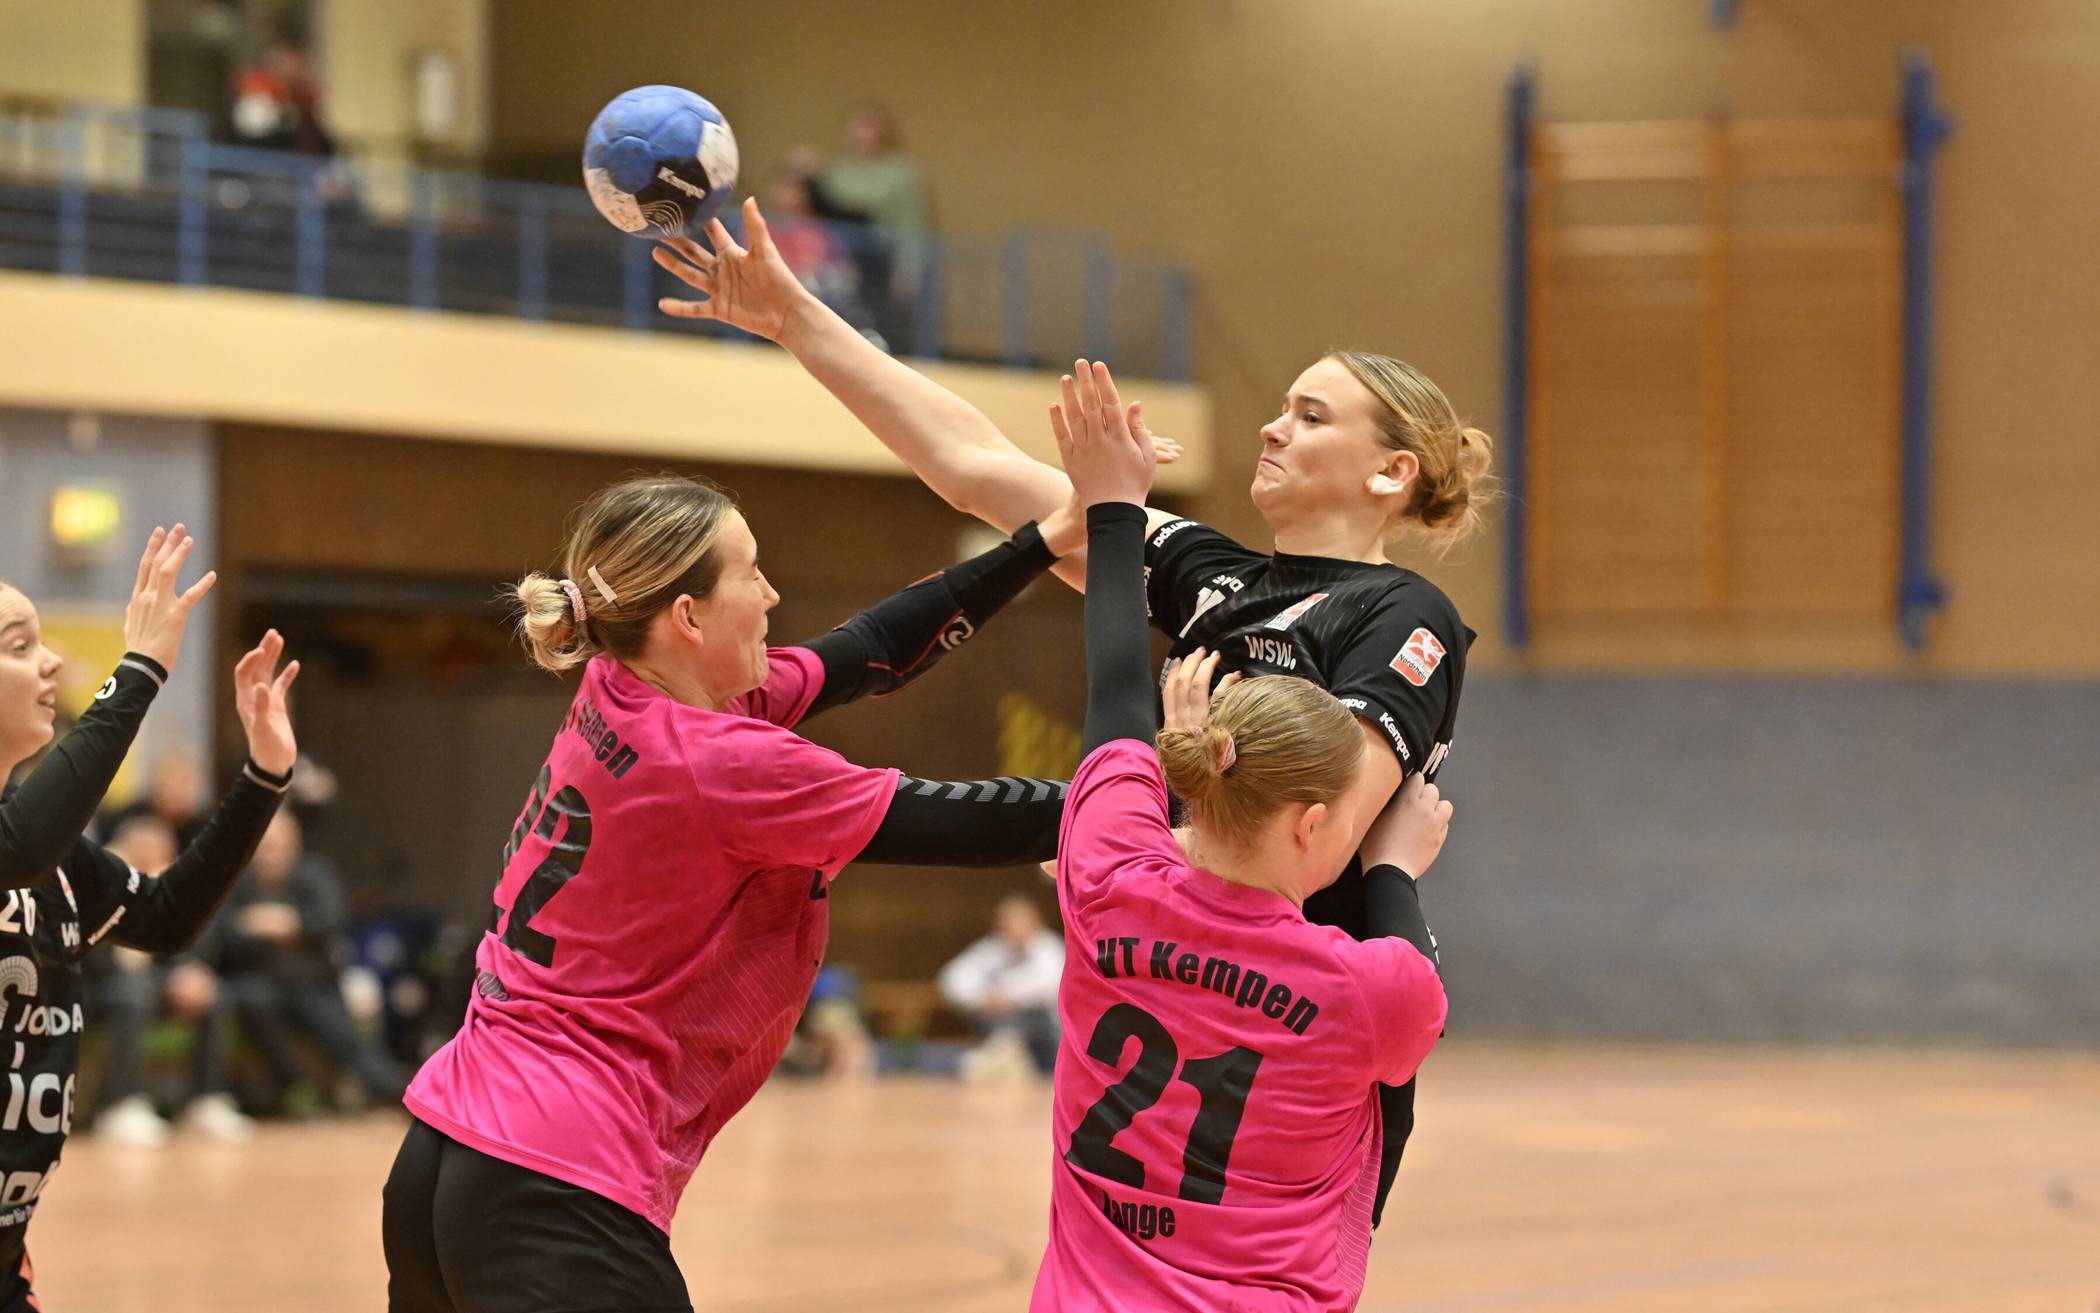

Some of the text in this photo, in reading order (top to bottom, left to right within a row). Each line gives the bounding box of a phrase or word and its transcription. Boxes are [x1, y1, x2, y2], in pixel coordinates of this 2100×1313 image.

[1399, 653, 1427, 681] Nordrhein
[1379, 712, 1411, 761] Kempa
[1096, 937, 1319, 1036] VT Kempen
[1064, 1002, 1264, 1206] 21
